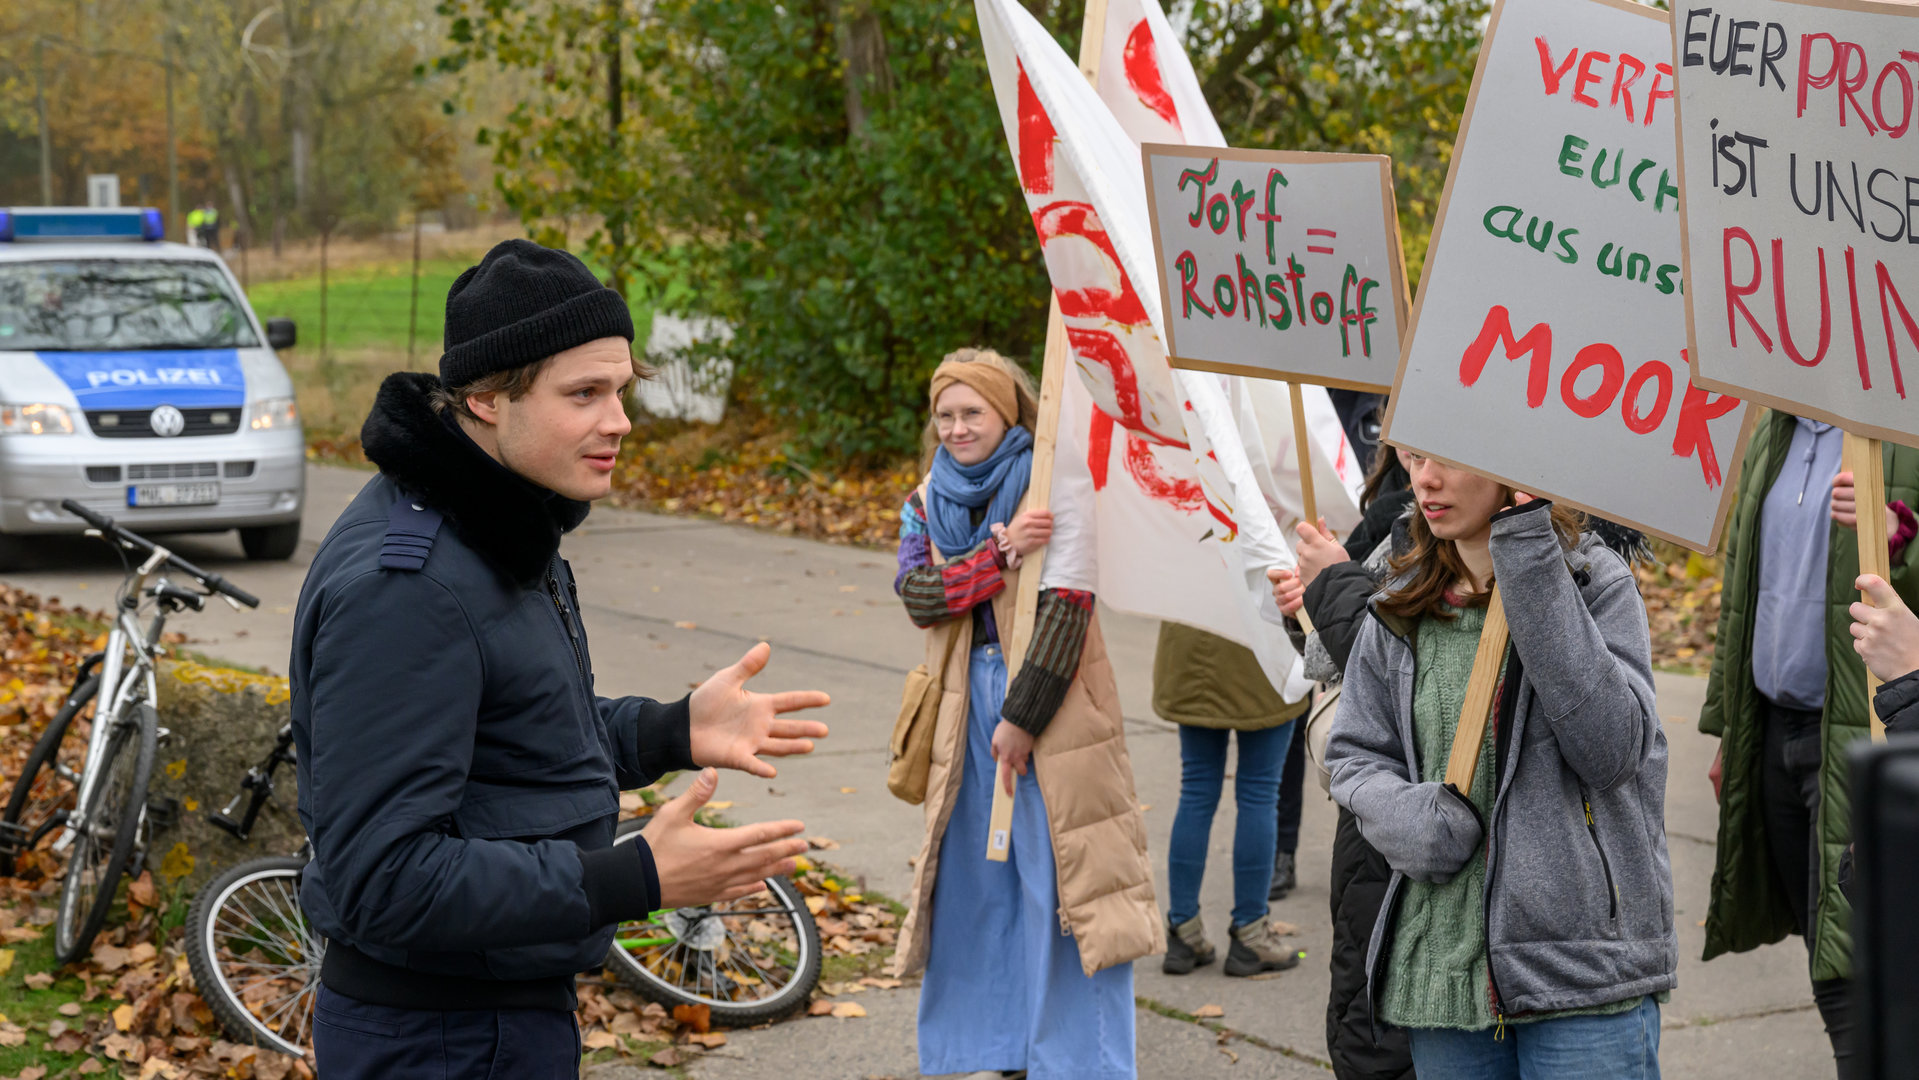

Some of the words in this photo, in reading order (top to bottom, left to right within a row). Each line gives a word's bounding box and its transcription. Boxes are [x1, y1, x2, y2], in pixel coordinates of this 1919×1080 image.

[1683, 8, 1787, 92] EUER
[1178, 157, 1289, 265] Torf
[1558, 135, 1679, 212] EUCH
[1483, 205, 1579, 264] aus
[1596, 243, 1684, 295] uns
[1175, 250, 1379, 358] Rohstoff
[86, 368, 222, 387] POLIZEI
[1458, 305, 1741, 491] MOOR
